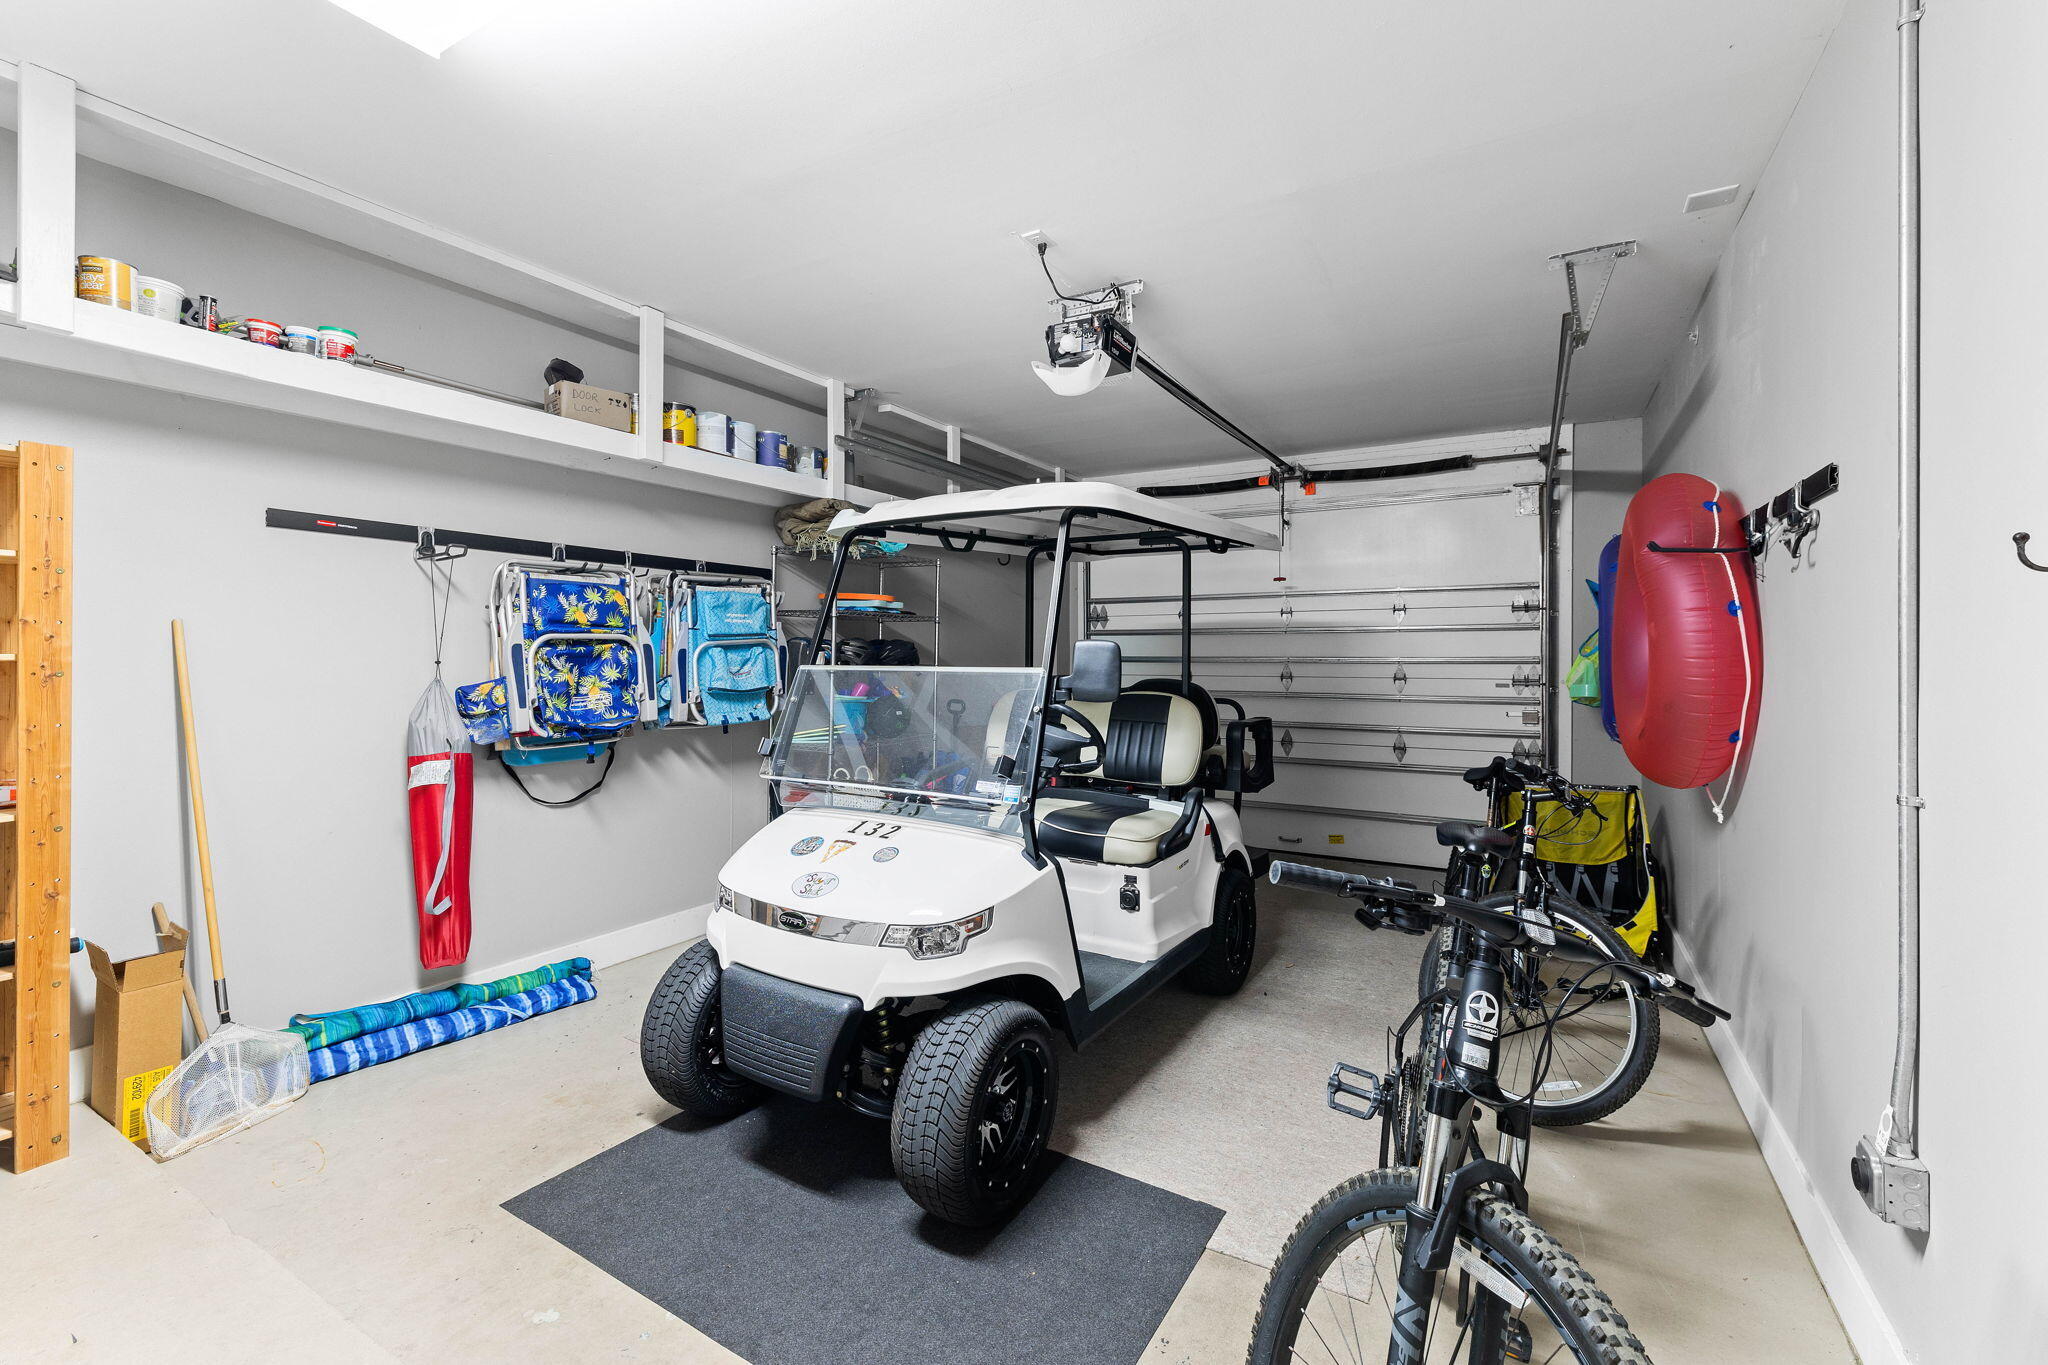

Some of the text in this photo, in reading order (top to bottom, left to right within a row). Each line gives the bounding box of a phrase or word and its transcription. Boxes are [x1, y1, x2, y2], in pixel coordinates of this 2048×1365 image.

[572, 389, 599, 402] DOOR
[574, 404, 602, 415] LOCK
[847, 820, 902, 839] 132
[780, 915, 803, 926] STAR
